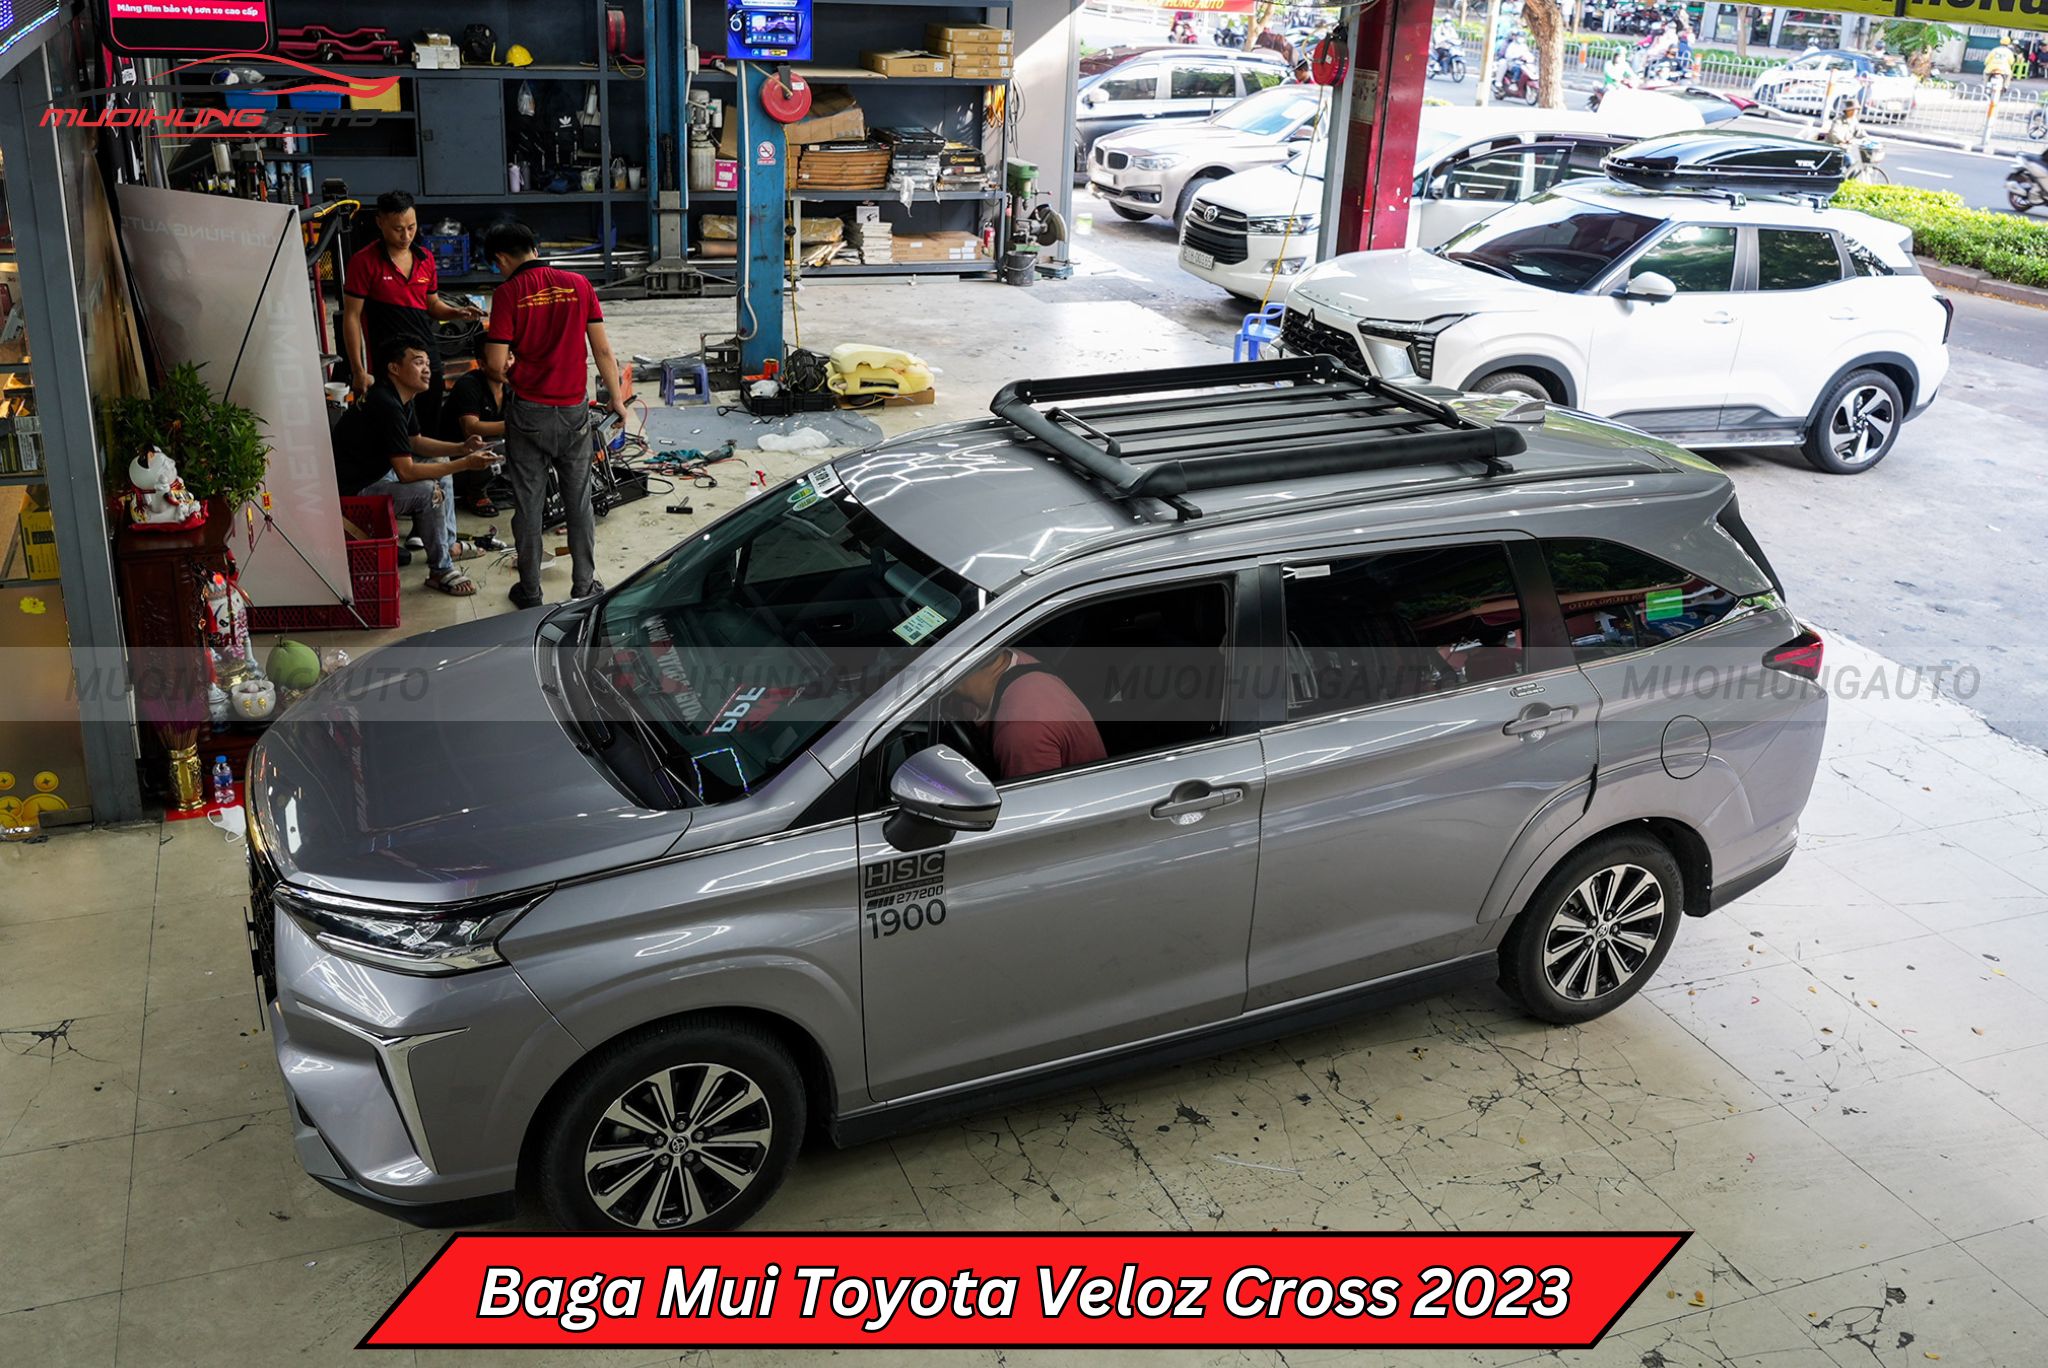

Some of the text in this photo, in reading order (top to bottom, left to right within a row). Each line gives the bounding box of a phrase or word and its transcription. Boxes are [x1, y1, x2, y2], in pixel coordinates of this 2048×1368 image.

[867, 853, 943, 886] HSC
[897, 885, 943, 904] 277200
[866, 899, 946, 939] 1900
